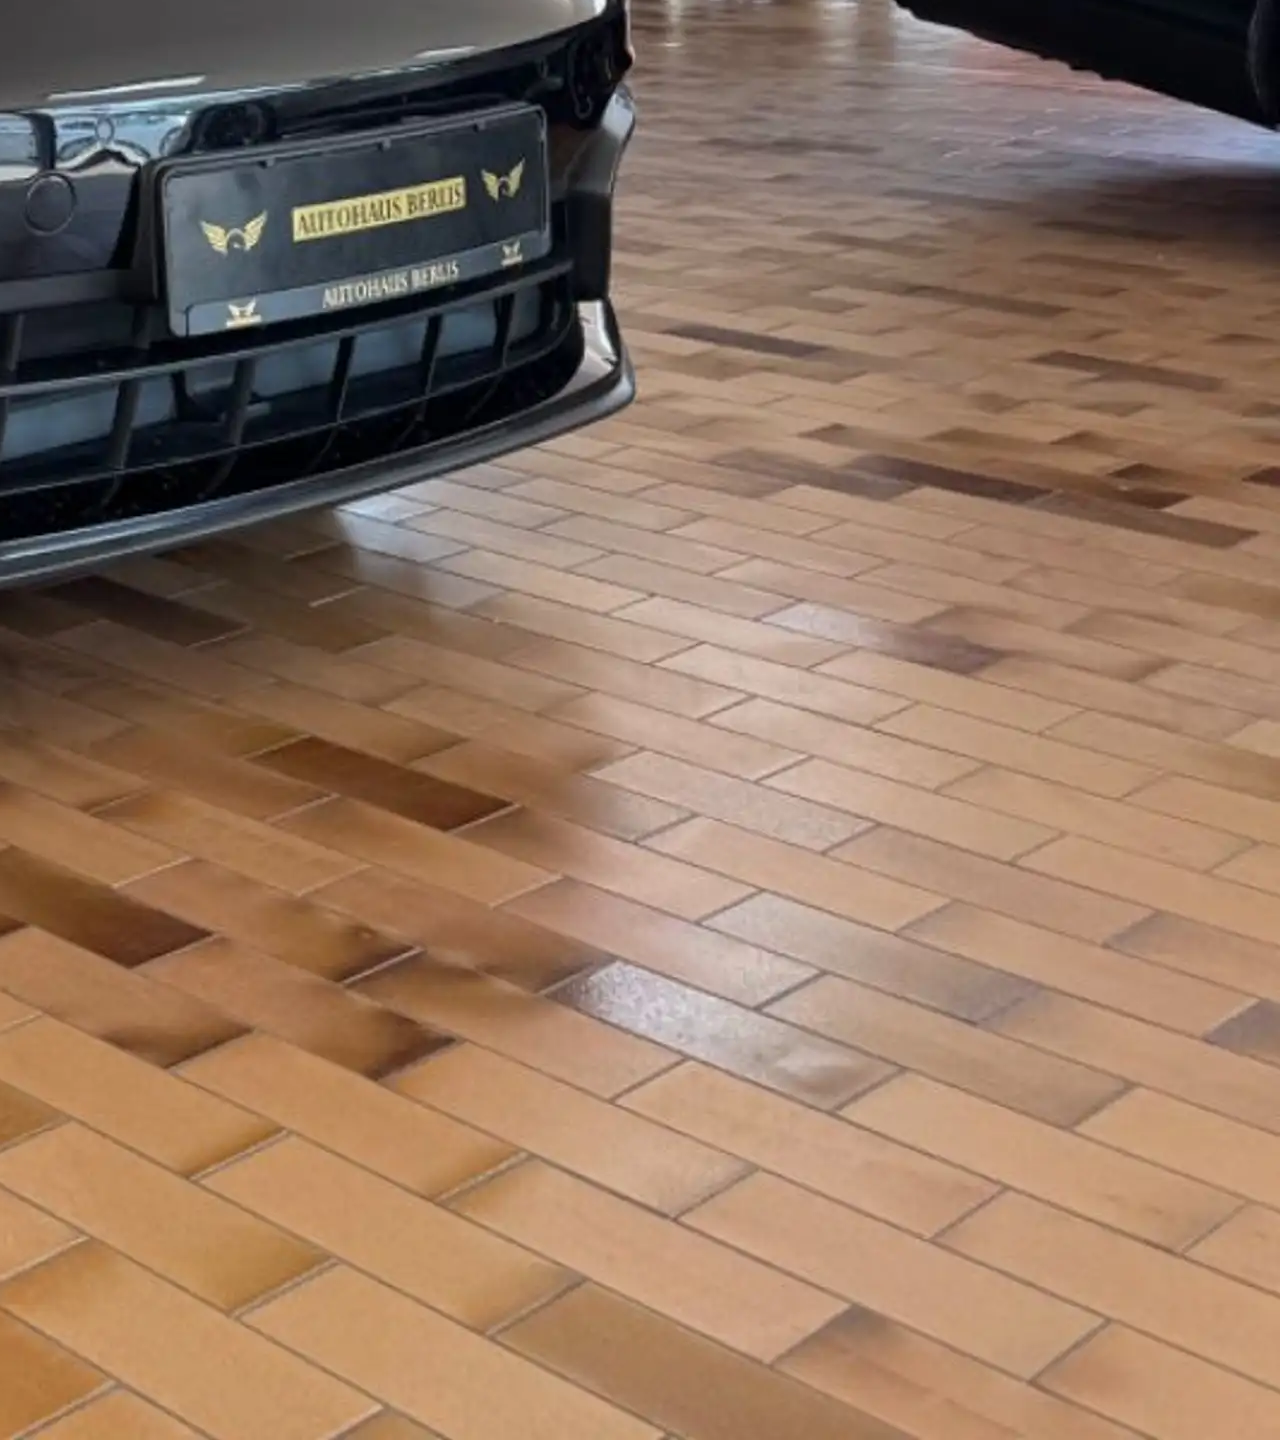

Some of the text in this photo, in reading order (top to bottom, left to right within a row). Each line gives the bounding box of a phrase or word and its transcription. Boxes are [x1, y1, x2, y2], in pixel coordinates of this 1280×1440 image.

[297, 182, 462, 235] AUTOHAUS BERLIS
[322, 274, 408, 309] AUTOHAUS
